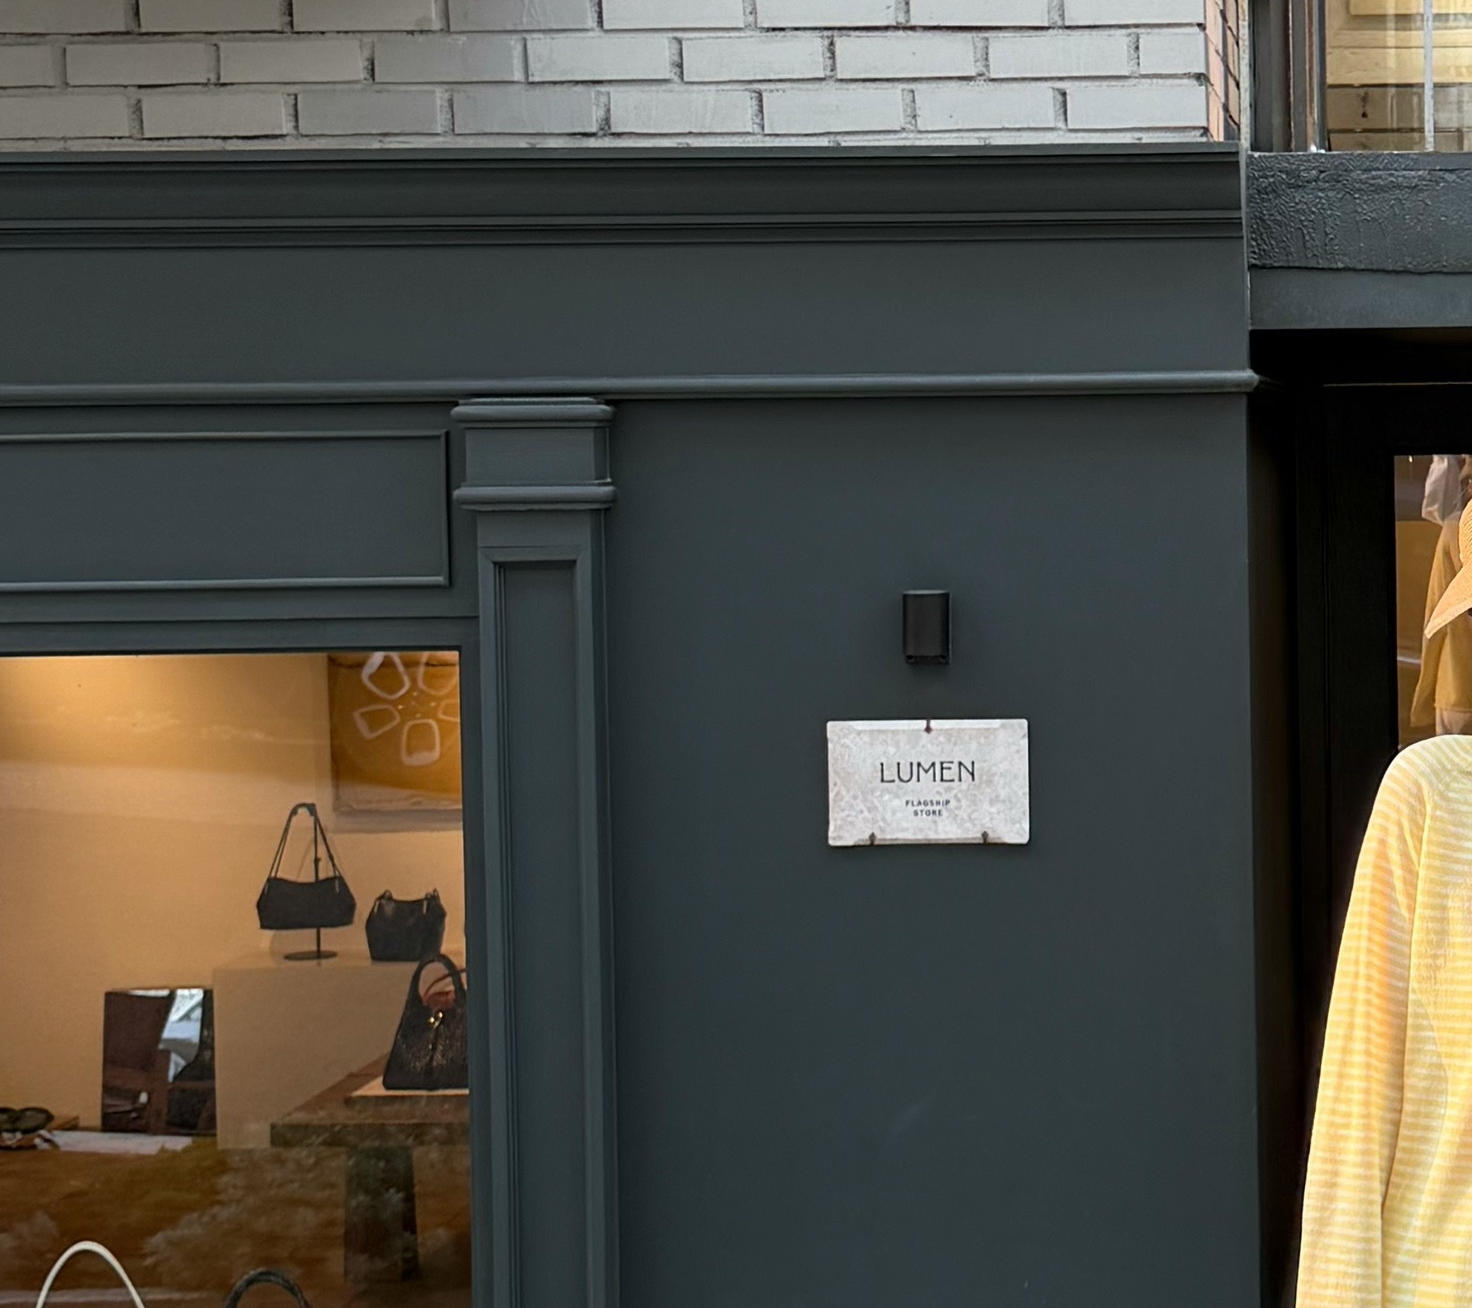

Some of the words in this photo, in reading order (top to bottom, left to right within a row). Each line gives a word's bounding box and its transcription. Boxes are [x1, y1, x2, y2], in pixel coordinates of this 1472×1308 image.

[880, 760, 975, 783] LUMEN
[905, 799, 951, 808] FLAGSHIP
[913, 809, 943, 817] STORE
